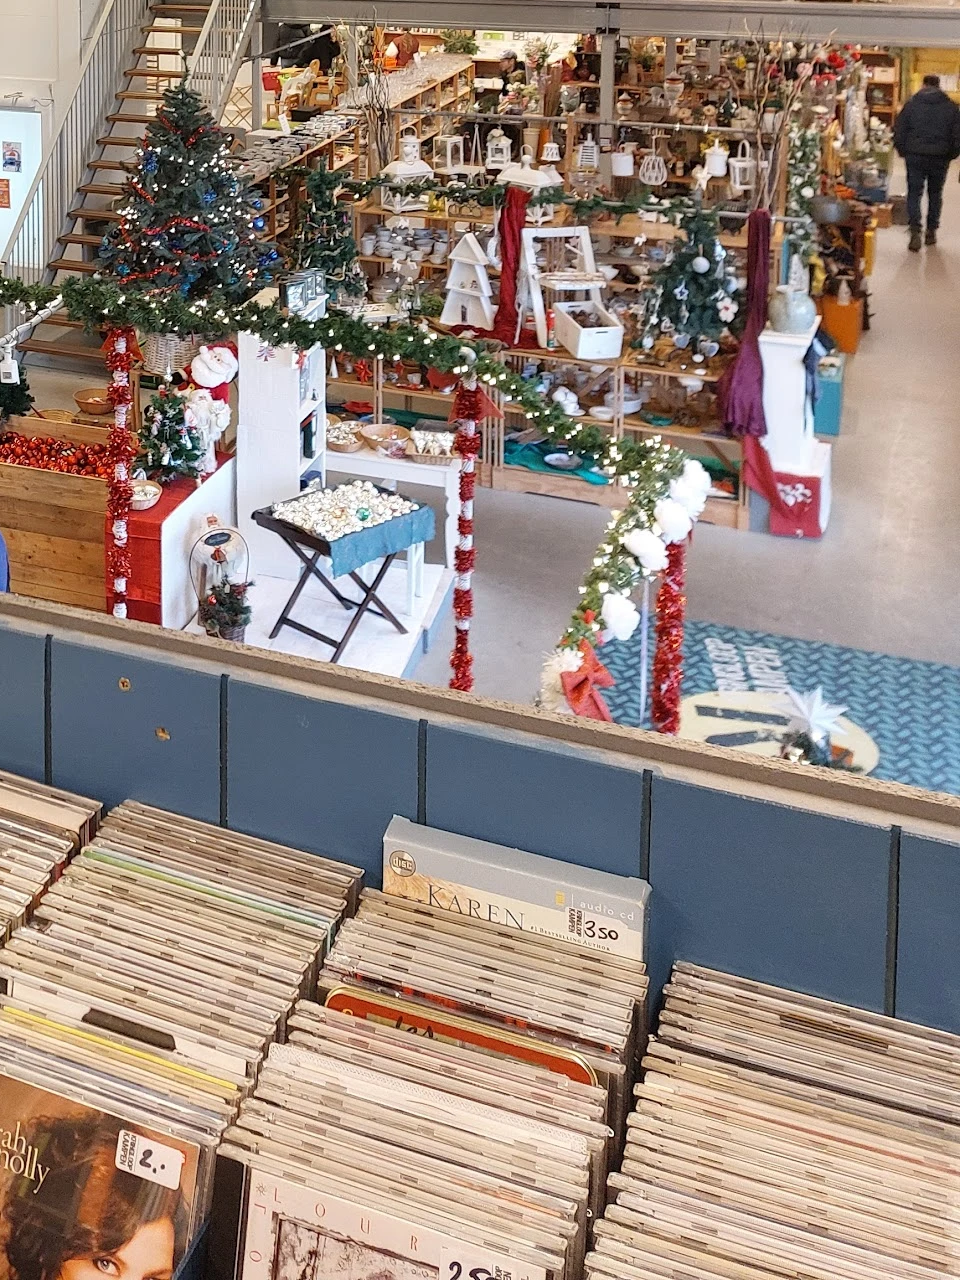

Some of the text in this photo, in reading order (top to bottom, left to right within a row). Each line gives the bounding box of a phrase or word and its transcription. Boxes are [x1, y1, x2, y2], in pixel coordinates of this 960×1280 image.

[428, 883, 526, 931] KAREN
[580, 901, 634, 921] audio cd
[120, 1132, 130, 1166] KAMPEN
